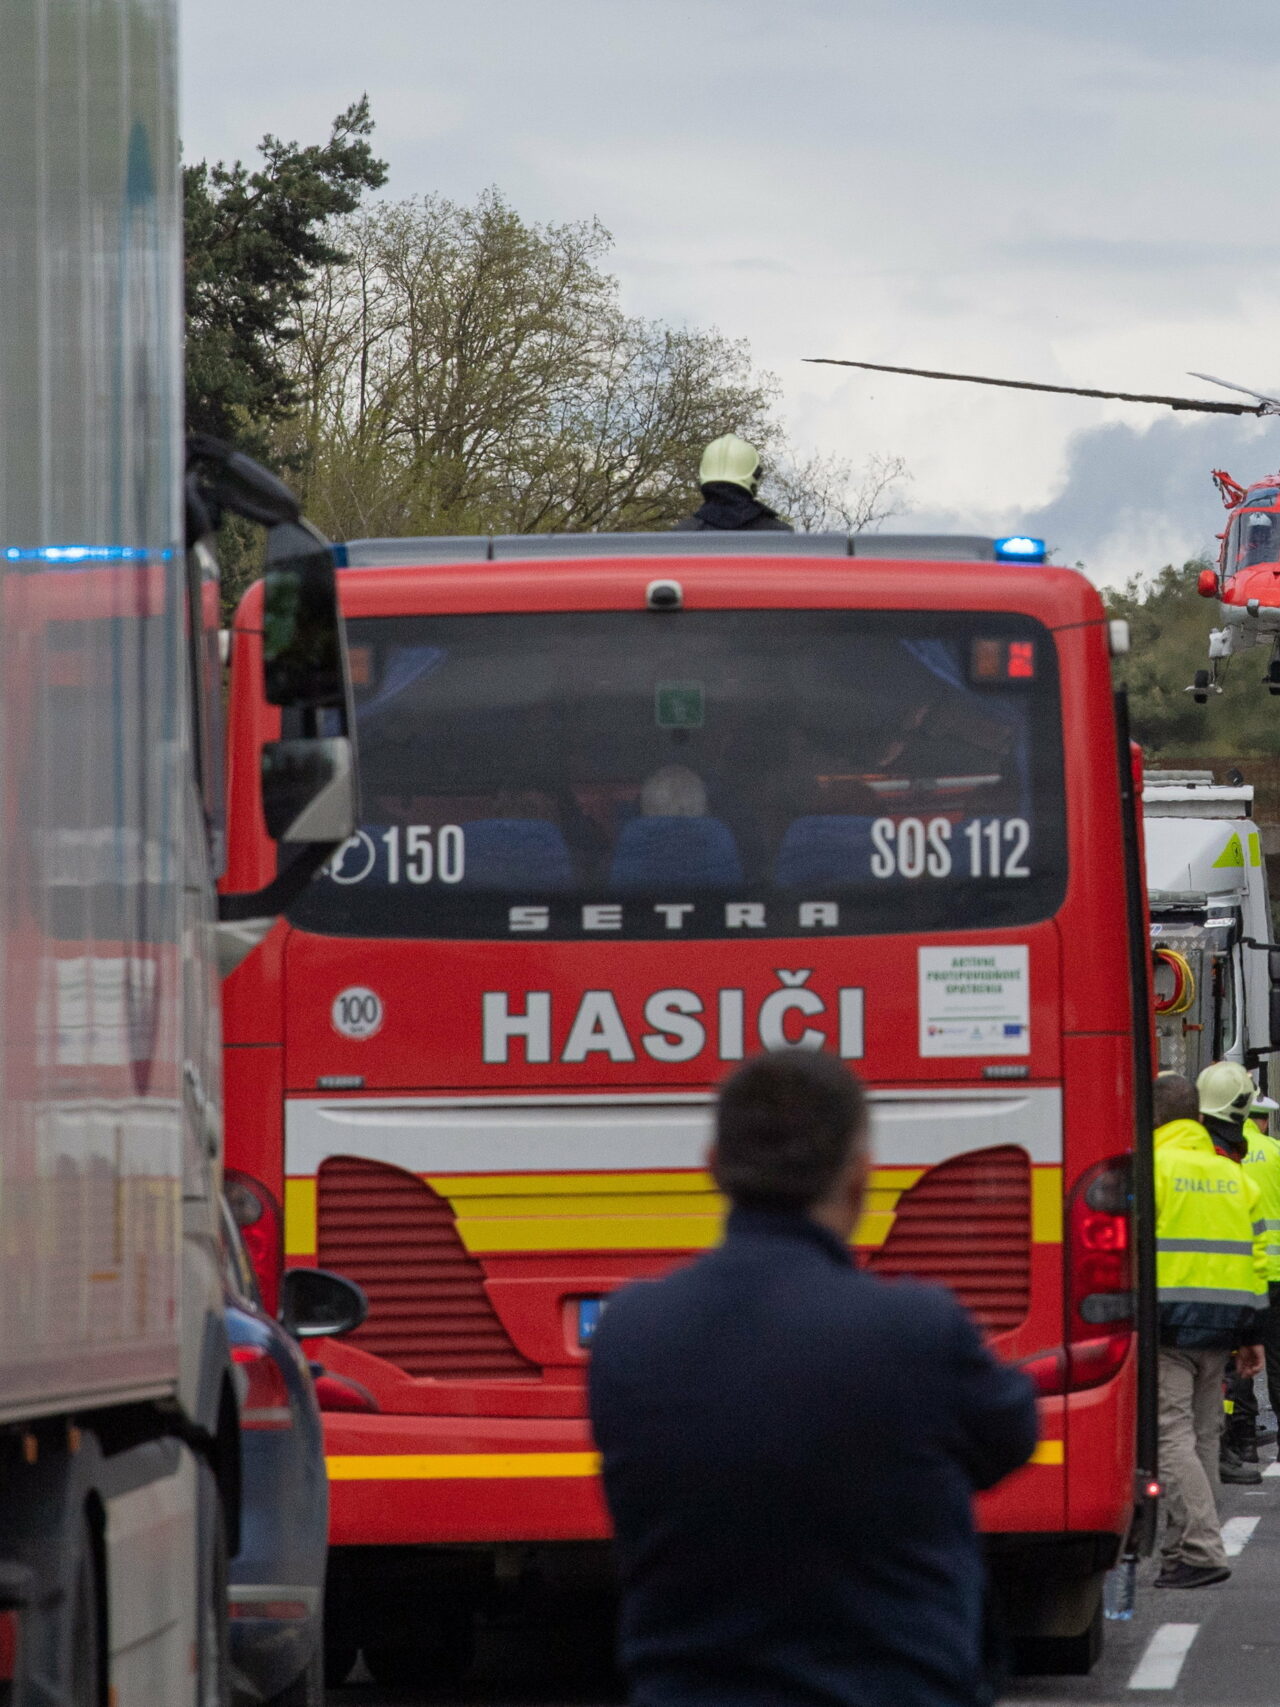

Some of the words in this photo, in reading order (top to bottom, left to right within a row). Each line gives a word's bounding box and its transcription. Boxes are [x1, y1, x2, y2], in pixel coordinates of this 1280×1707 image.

[381, 824, 466, 884] 150
[870, 817, 952, 879] SOS
[964, 818, 1032, 878] 112
[508, 902, 840, 932] SETRA
[340, 994, 379, 1025] 100
[482, 968, 866, 1064] HASIČI
[1174, 1177, 1240, 1195] ZNALEC
